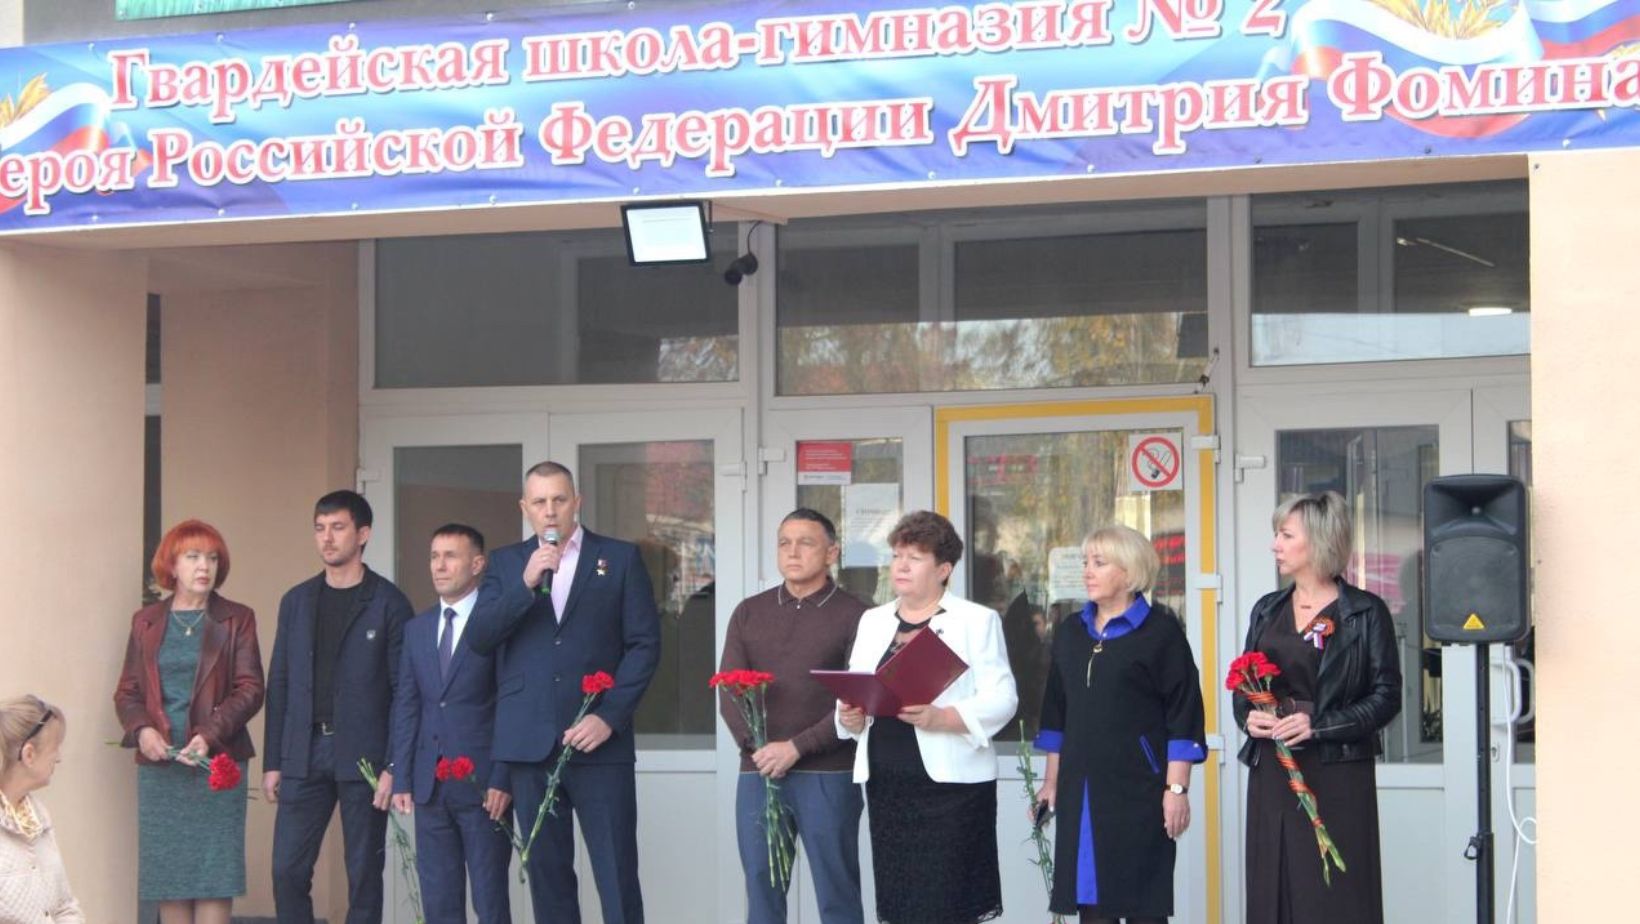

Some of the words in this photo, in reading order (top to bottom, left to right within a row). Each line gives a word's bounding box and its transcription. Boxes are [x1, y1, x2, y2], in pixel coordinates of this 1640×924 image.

[110, 38, 505, 119] Гвардейская
[527, 2, 1108, 77] школа-гимназия
[151, 116, 519, 183] Российской
[542, 102, 930, 173] Федерации
[952, 78, 1305, 150] Дмитрия
[1332, 55, 1640, 116] Фомина
